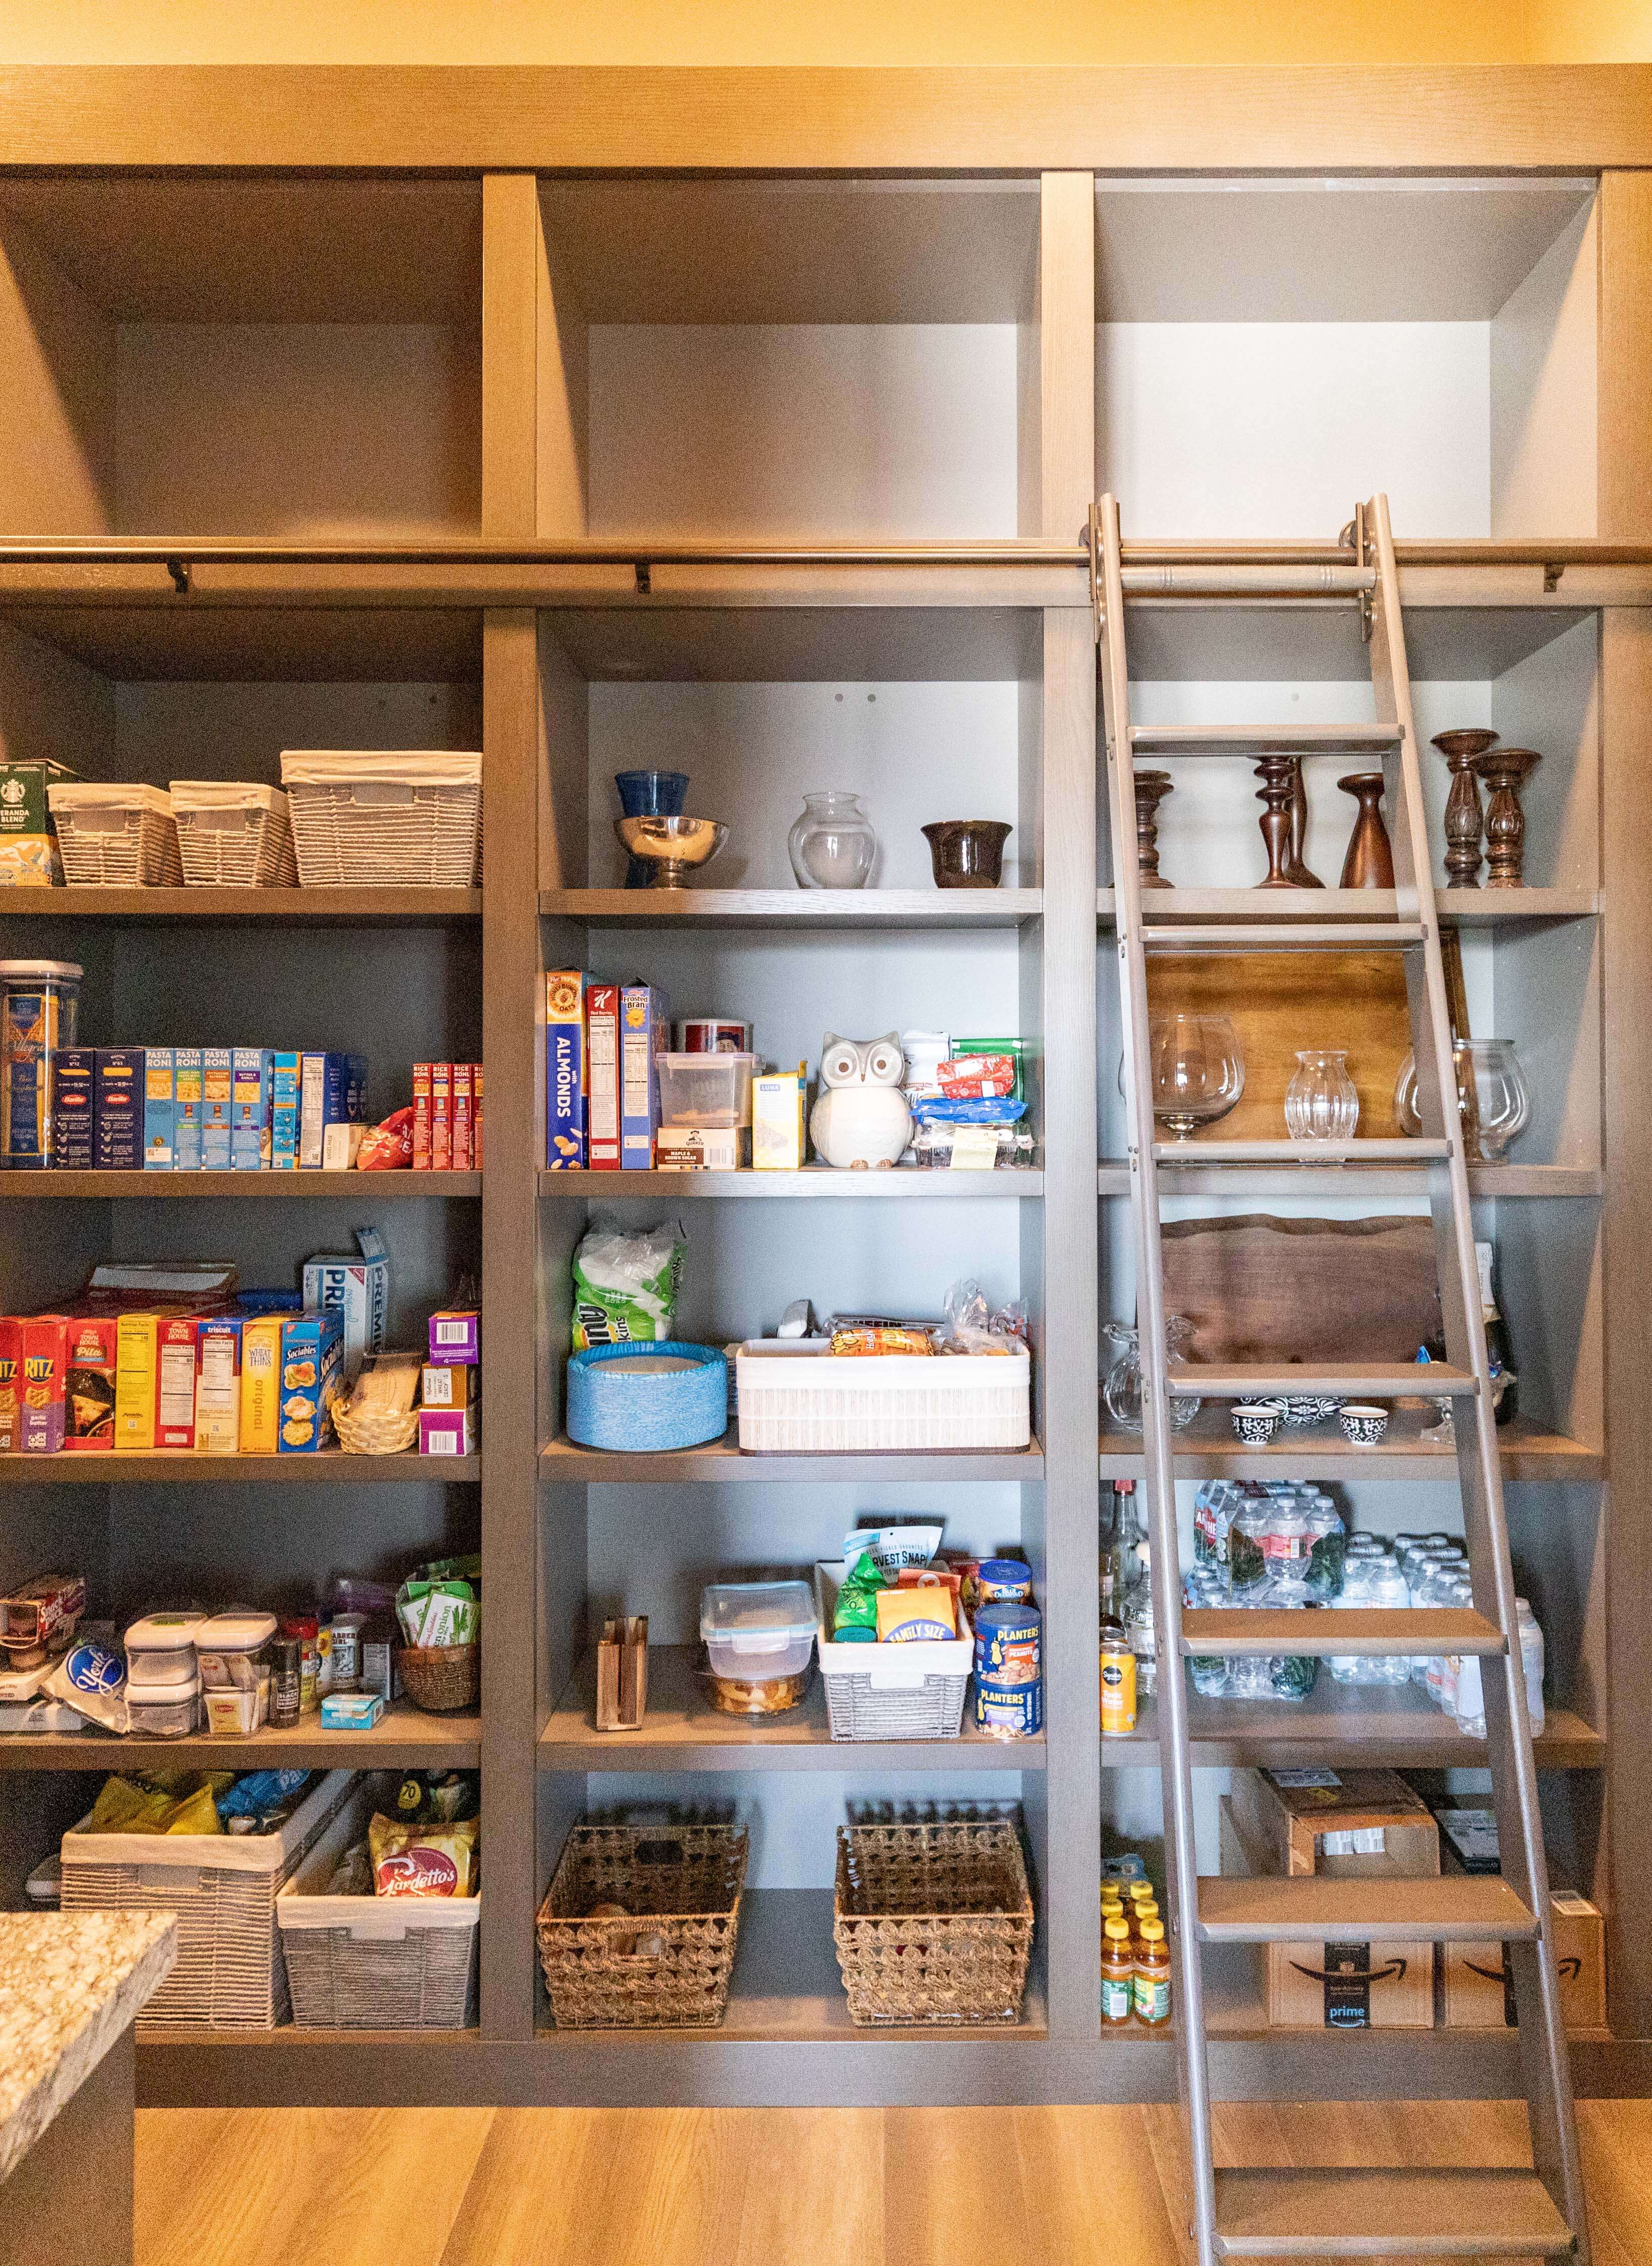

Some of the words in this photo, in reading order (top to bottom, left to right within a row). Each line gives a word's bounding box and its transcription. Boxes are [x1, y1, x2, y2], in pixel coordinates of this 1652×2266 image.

[551, 984, 561, 1000] HONEY
[594, 990, 612, 1009] K
[559, 1003, 575, 1011] OATS
[557, 1037, 571, 1117] ALMONDS
[77, 1346, 102, 1356] Pita
[248, 1348, 272, 1357] WHEAT
[287, 1346, 316, 1361] Sociables
[25, 1357, 54, 1378] RITZ
[249, 1356, 271, 1366] THINS
[0, 1361, 17, 1378] ITZ
[253, 1380, 263, 1430] original
[873, 1553, 900, 1567] RVEST
[437, 1605, 452, 1634] onion
[889, 1624, 921, 1642] FAMILY
[924, 1624, 945, 1640] SIZE
[998, 1626, 1038, 1641] PLANTERS
[981, 1689, 1023, 1704] PLANTERS
[378, 1857, 455, 1897] Gardetto's
[1330, 2006, 1365, 2019] prime
